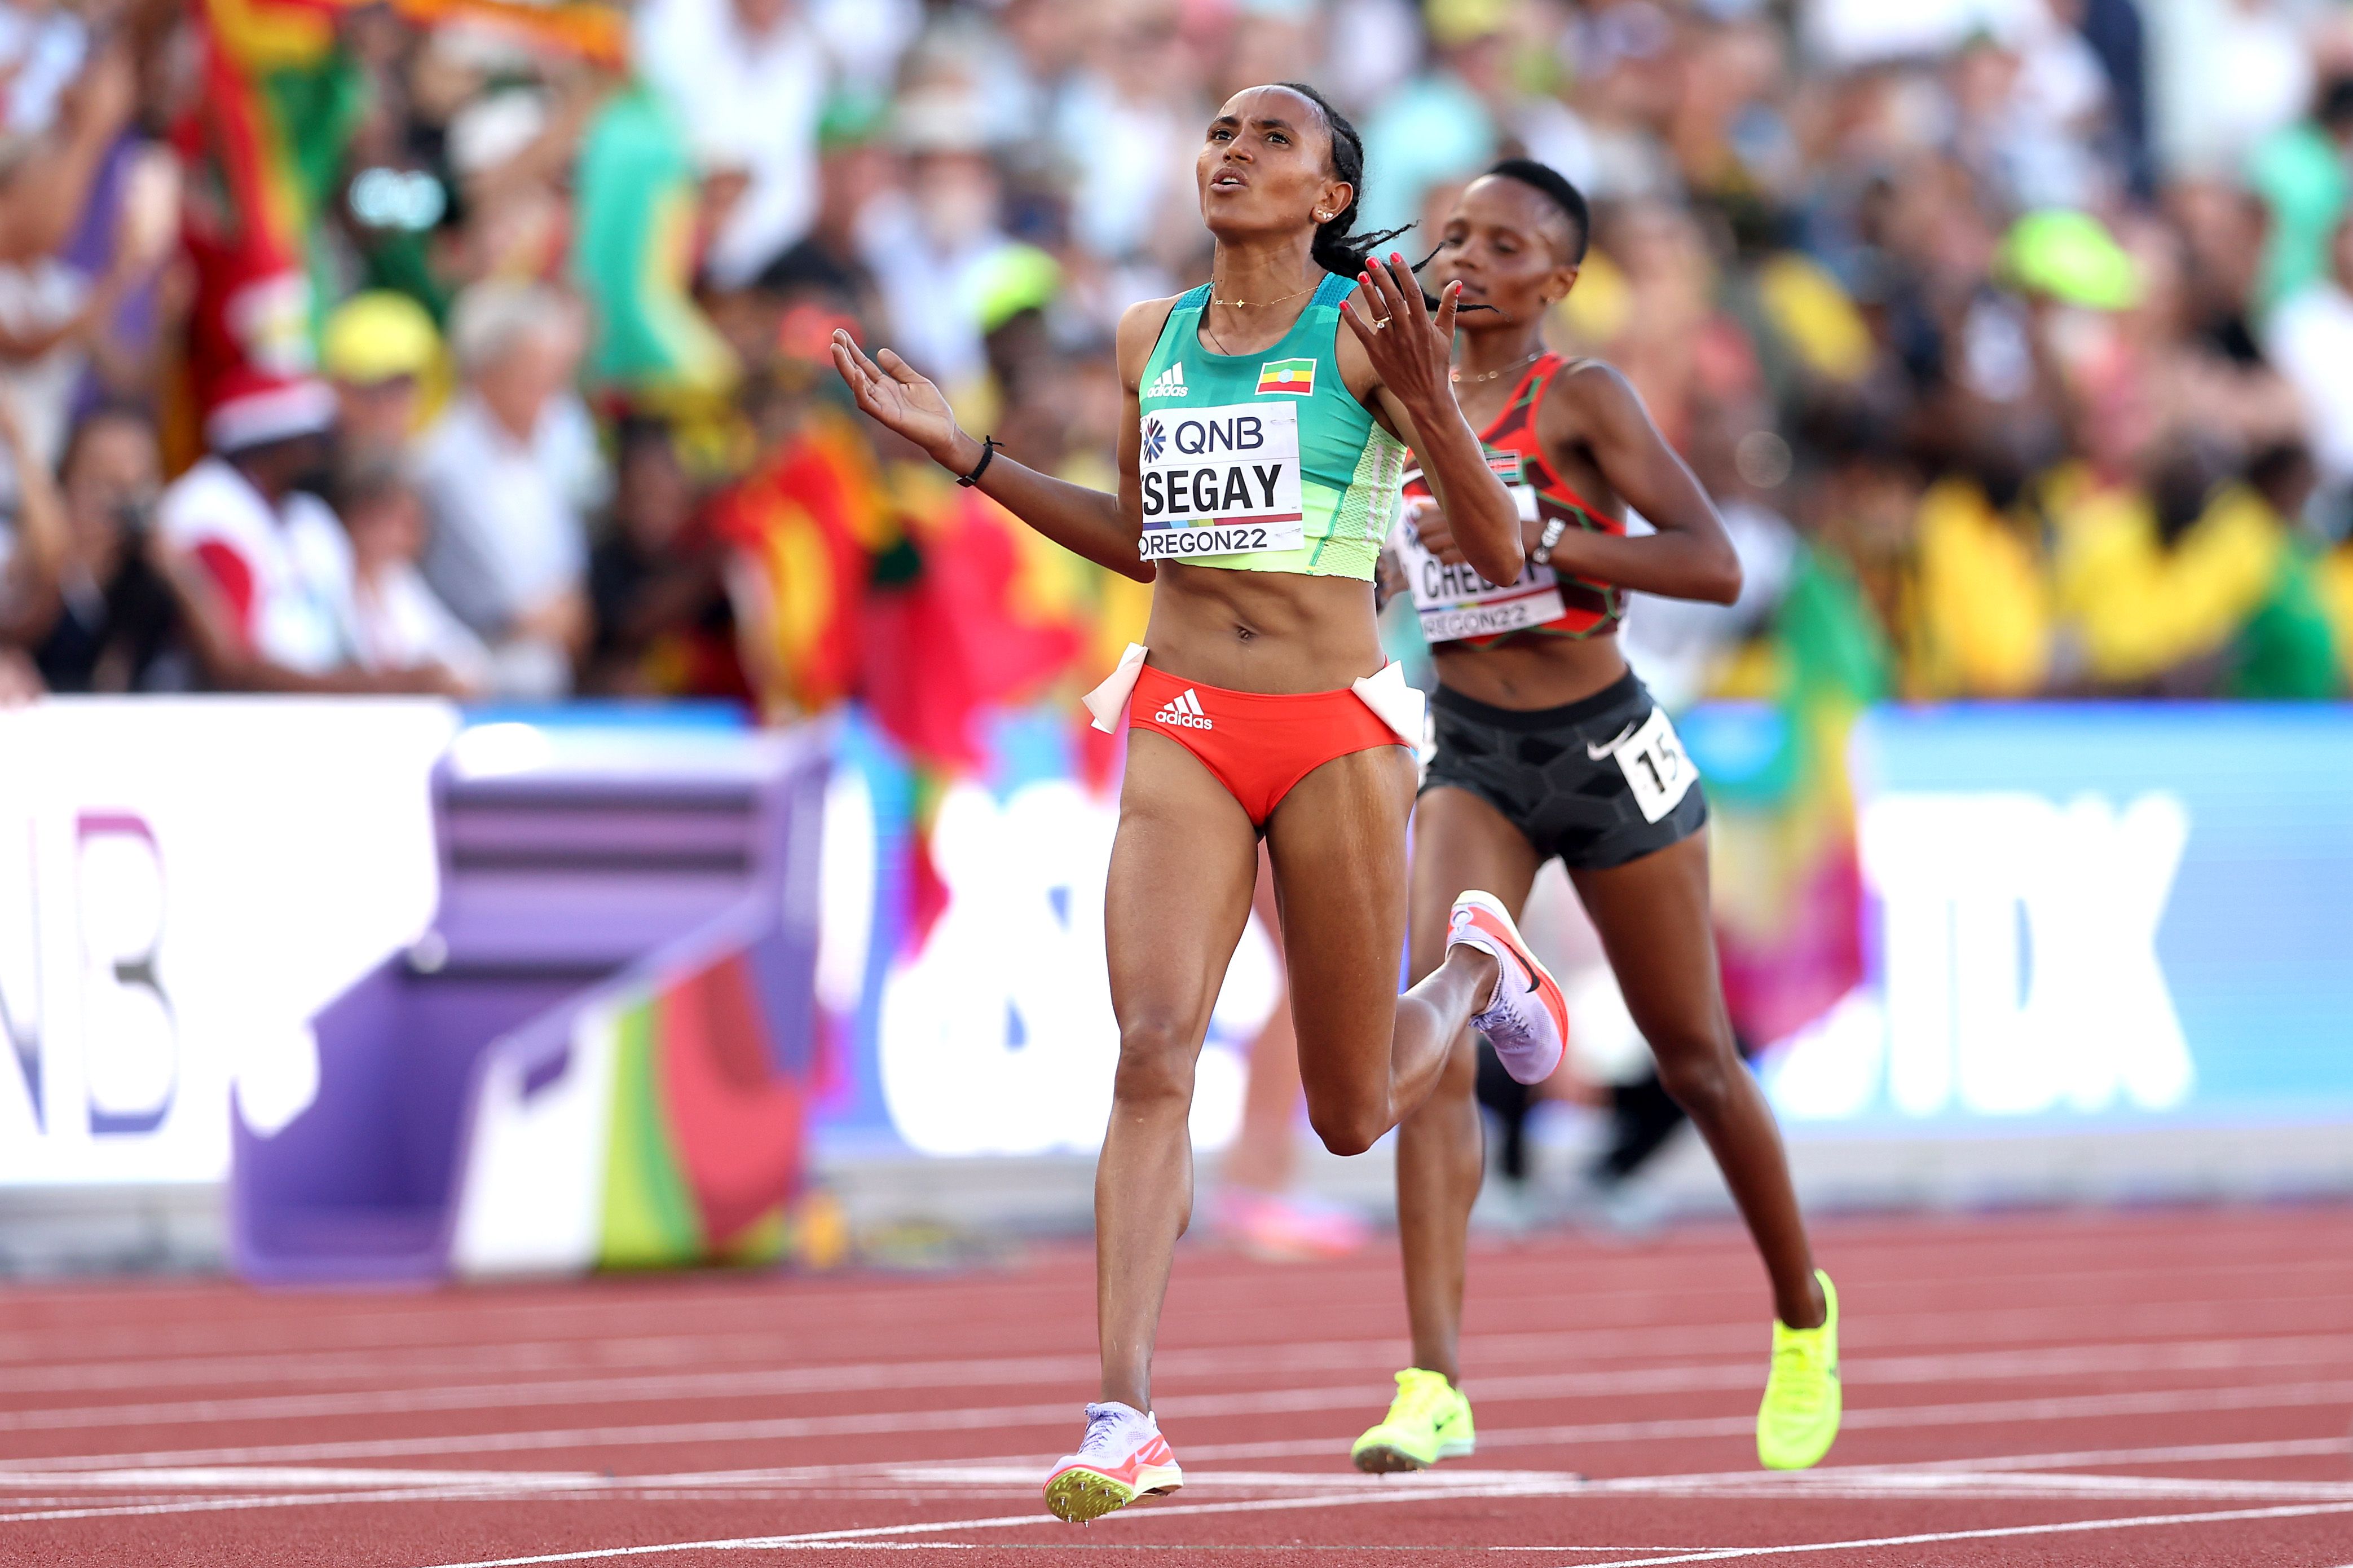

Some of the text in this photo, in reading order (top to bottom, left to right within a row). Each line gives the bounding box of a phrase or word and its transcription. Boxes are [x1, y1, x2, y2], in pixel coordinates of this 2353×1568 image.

[1147, 383, 1189, 398] adidas
[1175, 416, 1264, 454] QNB
[1142, 464, 1283, 516] SEGAY
[1155, 710, 1213, 730] adidas
[1636, 732, 1679, 794] 15
